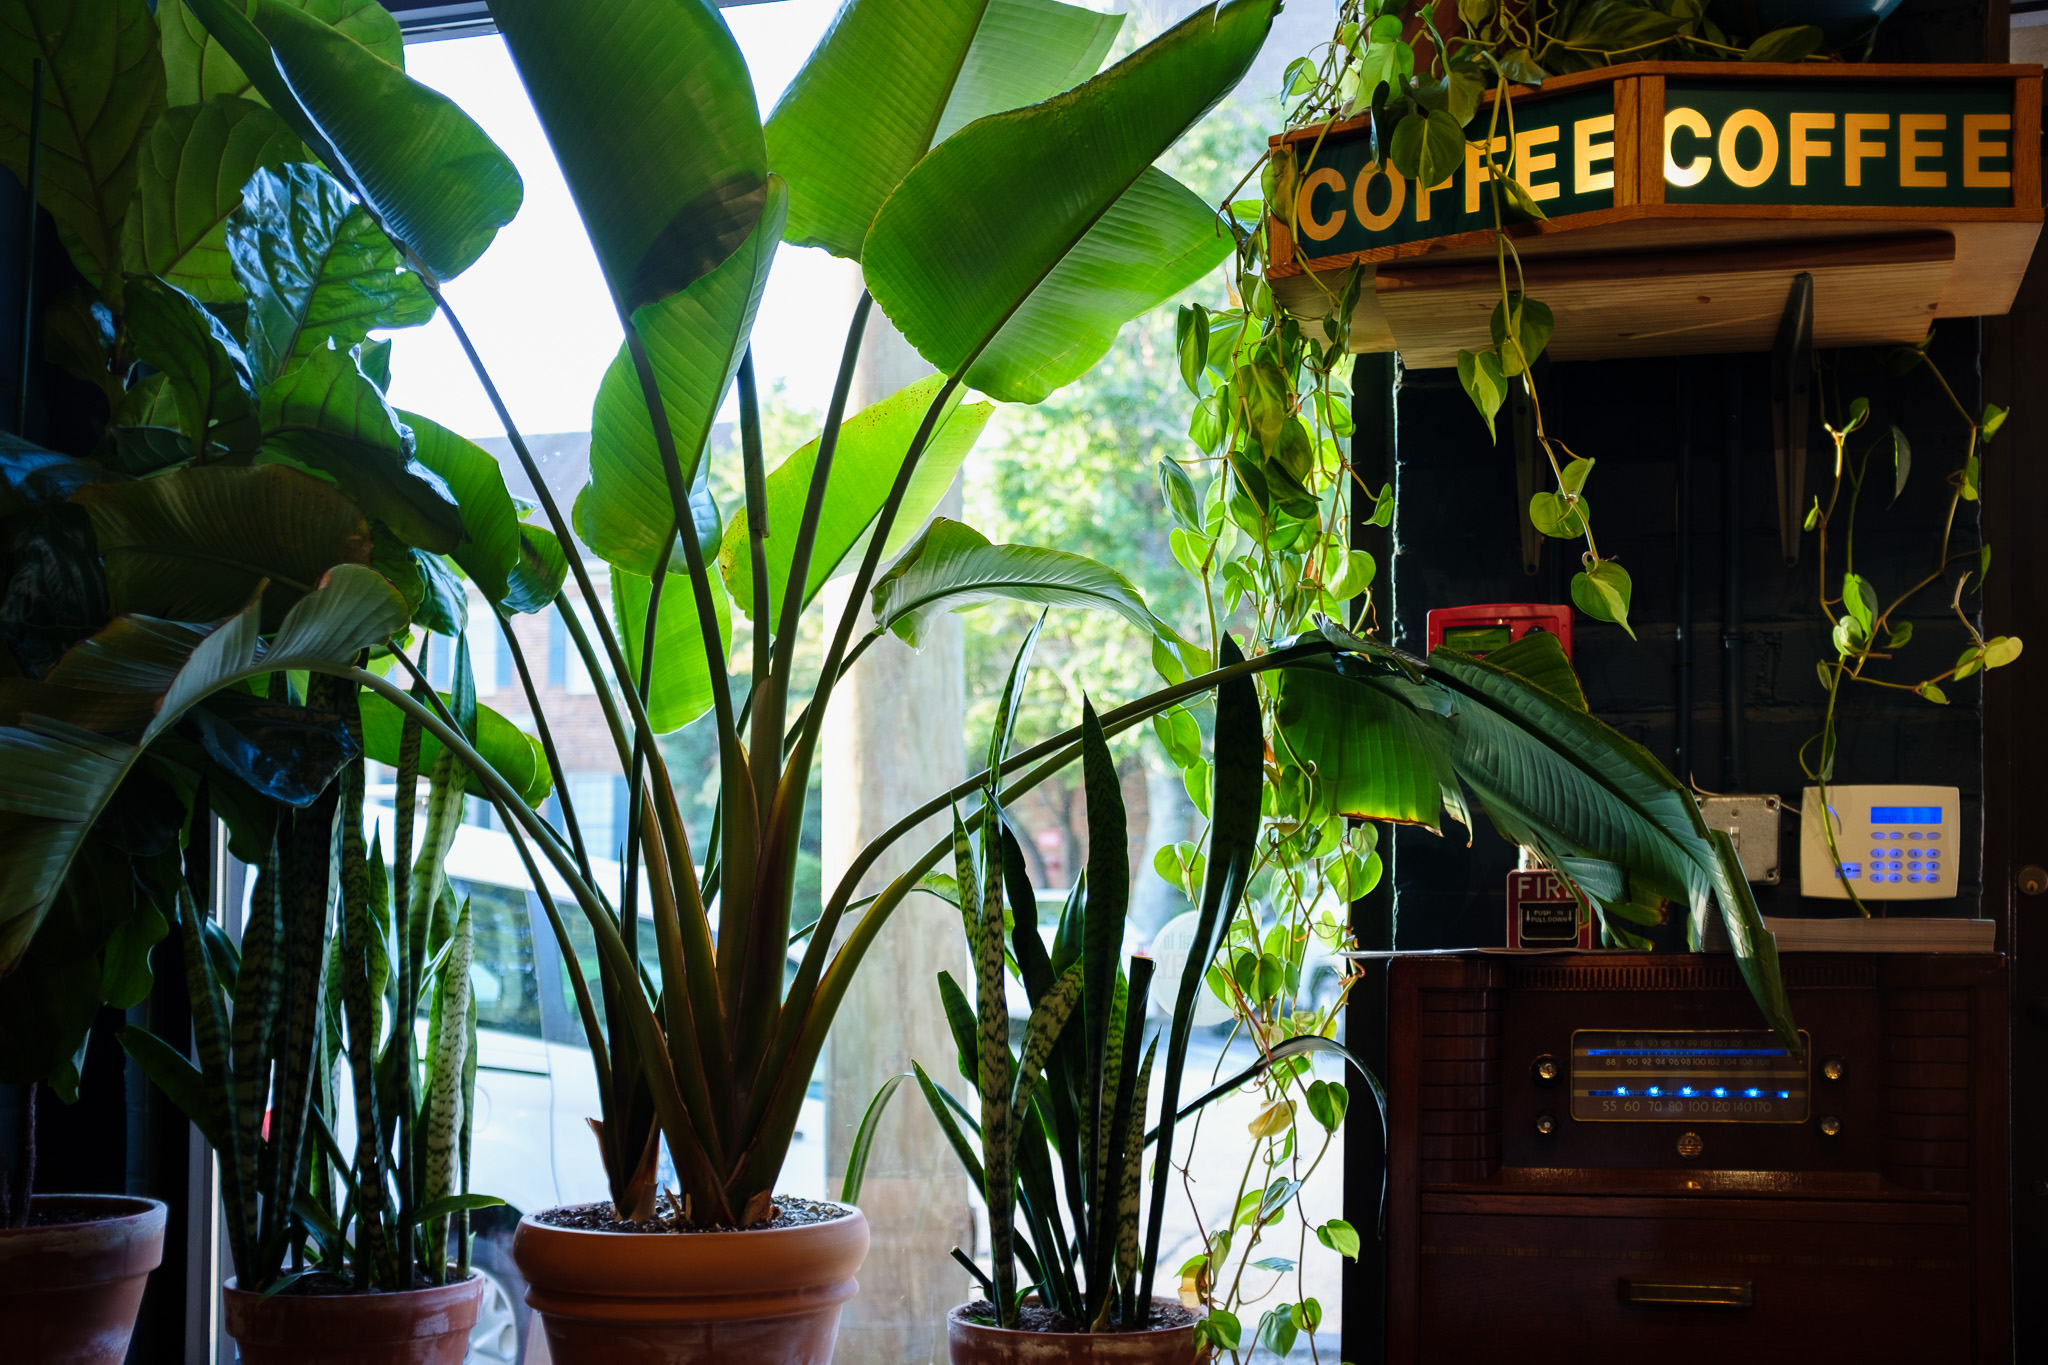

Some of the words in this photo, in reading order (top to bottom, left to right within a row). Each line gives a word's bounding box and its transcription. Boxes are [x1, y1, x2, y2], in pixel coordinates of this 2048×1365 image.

[1663, 106, 2012, 189] COFFEE
[1615, 1039, 1626, 1048] 89
[1634, 1039, 1643, 1048] 91
[1648, 1039, 1658, 1048] 93
[1660, 1039, 1671, 1048] 95
[1673, 1039, 1684, 1048] 97
[1687, 1039, 1698, 1048] 99
[1700, 1039, 1712, 1048] 101
[1605, 1058, 1616, 1066] 88
[1626, 1058, 1638, 1066] 90
[1641, 1058, 1652, 1066] 92
[1655, 1058, 1666, 1066] 94
[1668, 1058, 1680, 1066] 96
[1680, 1058, 1691, 1066] 98
[1692, 1058, 1707, 1066] 100
[1707, 1058, 1720, 1066] 102
[1724, 1058, 1737, 1066] 104
[1740, 1058, 1753, 1066] 106
[1602, 1101, 1617, 1112] 55
[1624, 1101, 1641, 1112] 60
[1649, 1101, 1663, 1112] 70
[1668, 1101, 1684, 1112] 80
[1688, 1101, 1709, 1112] 100
[1712, 1101, 1731, 1112] 120
[1733, 1101, 1752, 1112] 140
[1753, 1101, 1772, 1112] 170
